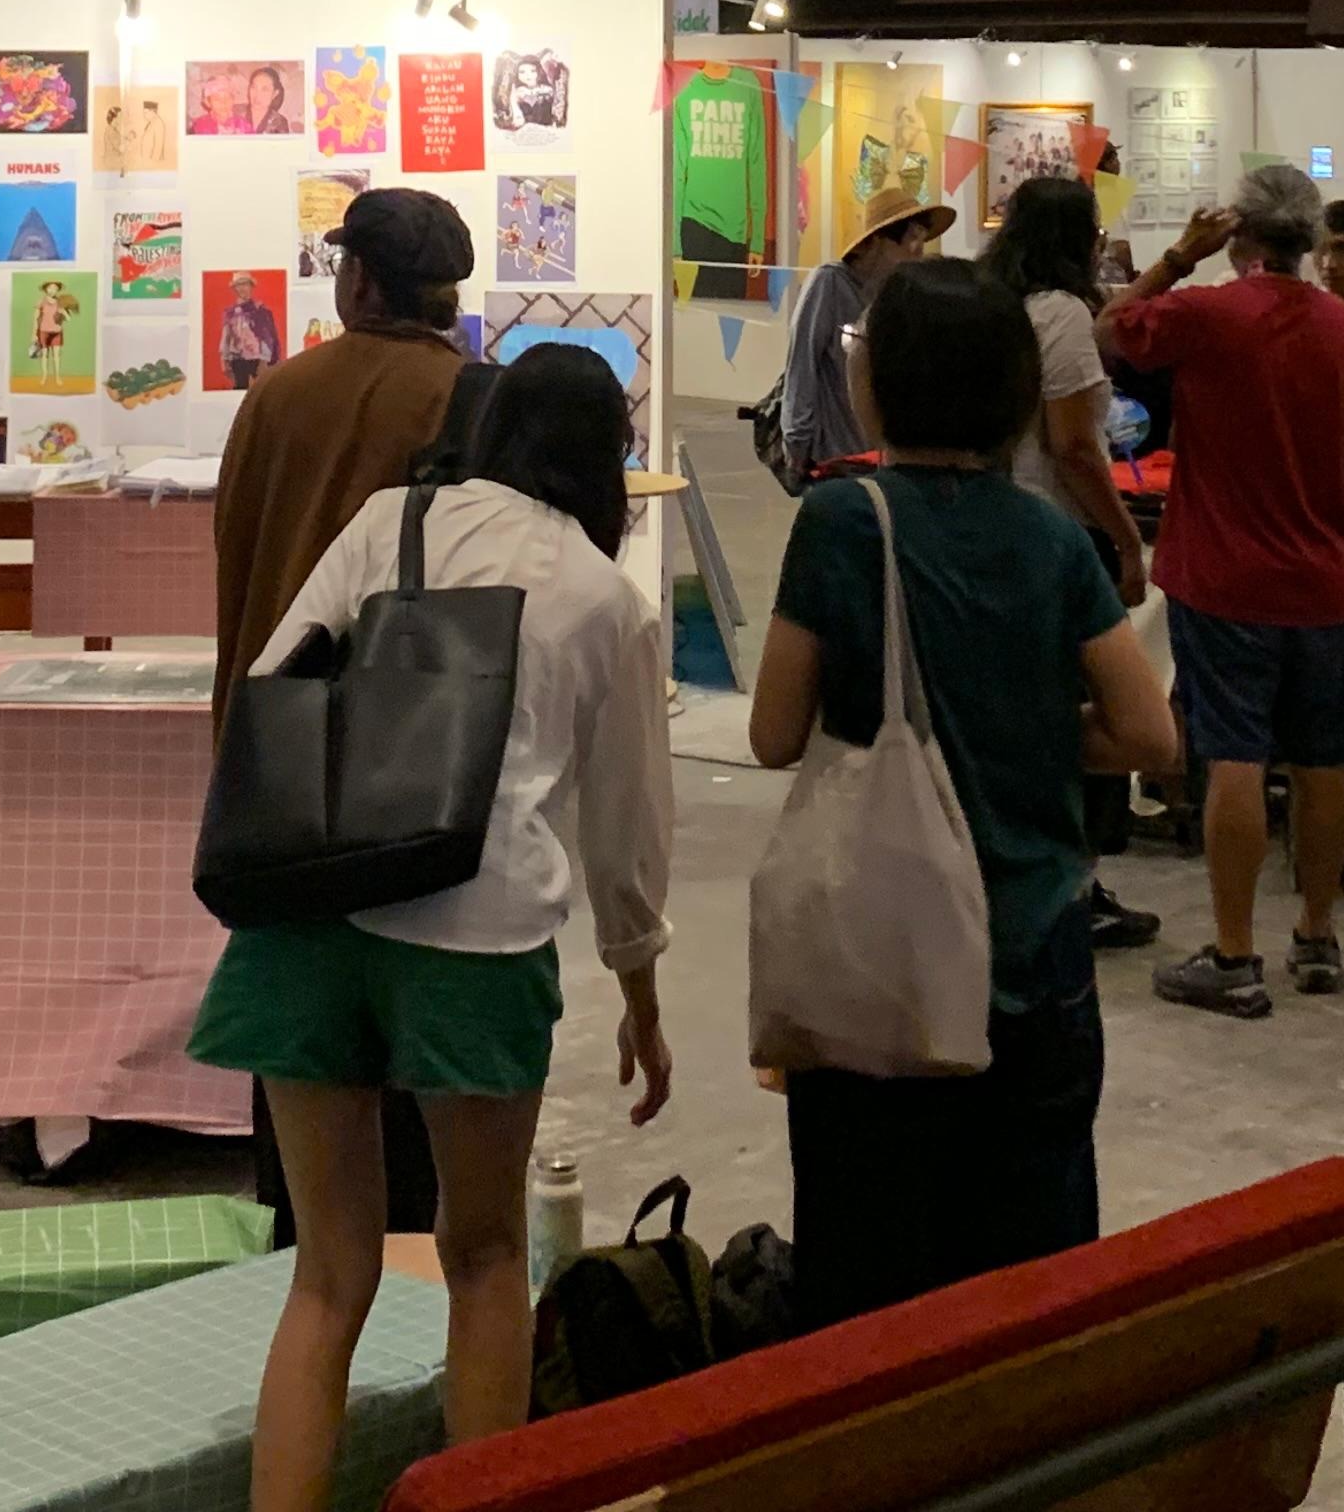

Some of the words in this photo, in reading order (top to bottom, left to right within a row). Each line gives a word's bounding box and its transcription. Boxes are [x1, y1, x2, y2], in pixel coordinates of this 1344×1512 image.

[675, 8, 710, 32] idak
[690, 100, 745, 122] PART
[691, 121, 744, 144] TIME
[690, 144, 743, 159] ARTIST
[7, 163, 60, 174] HUMANS
